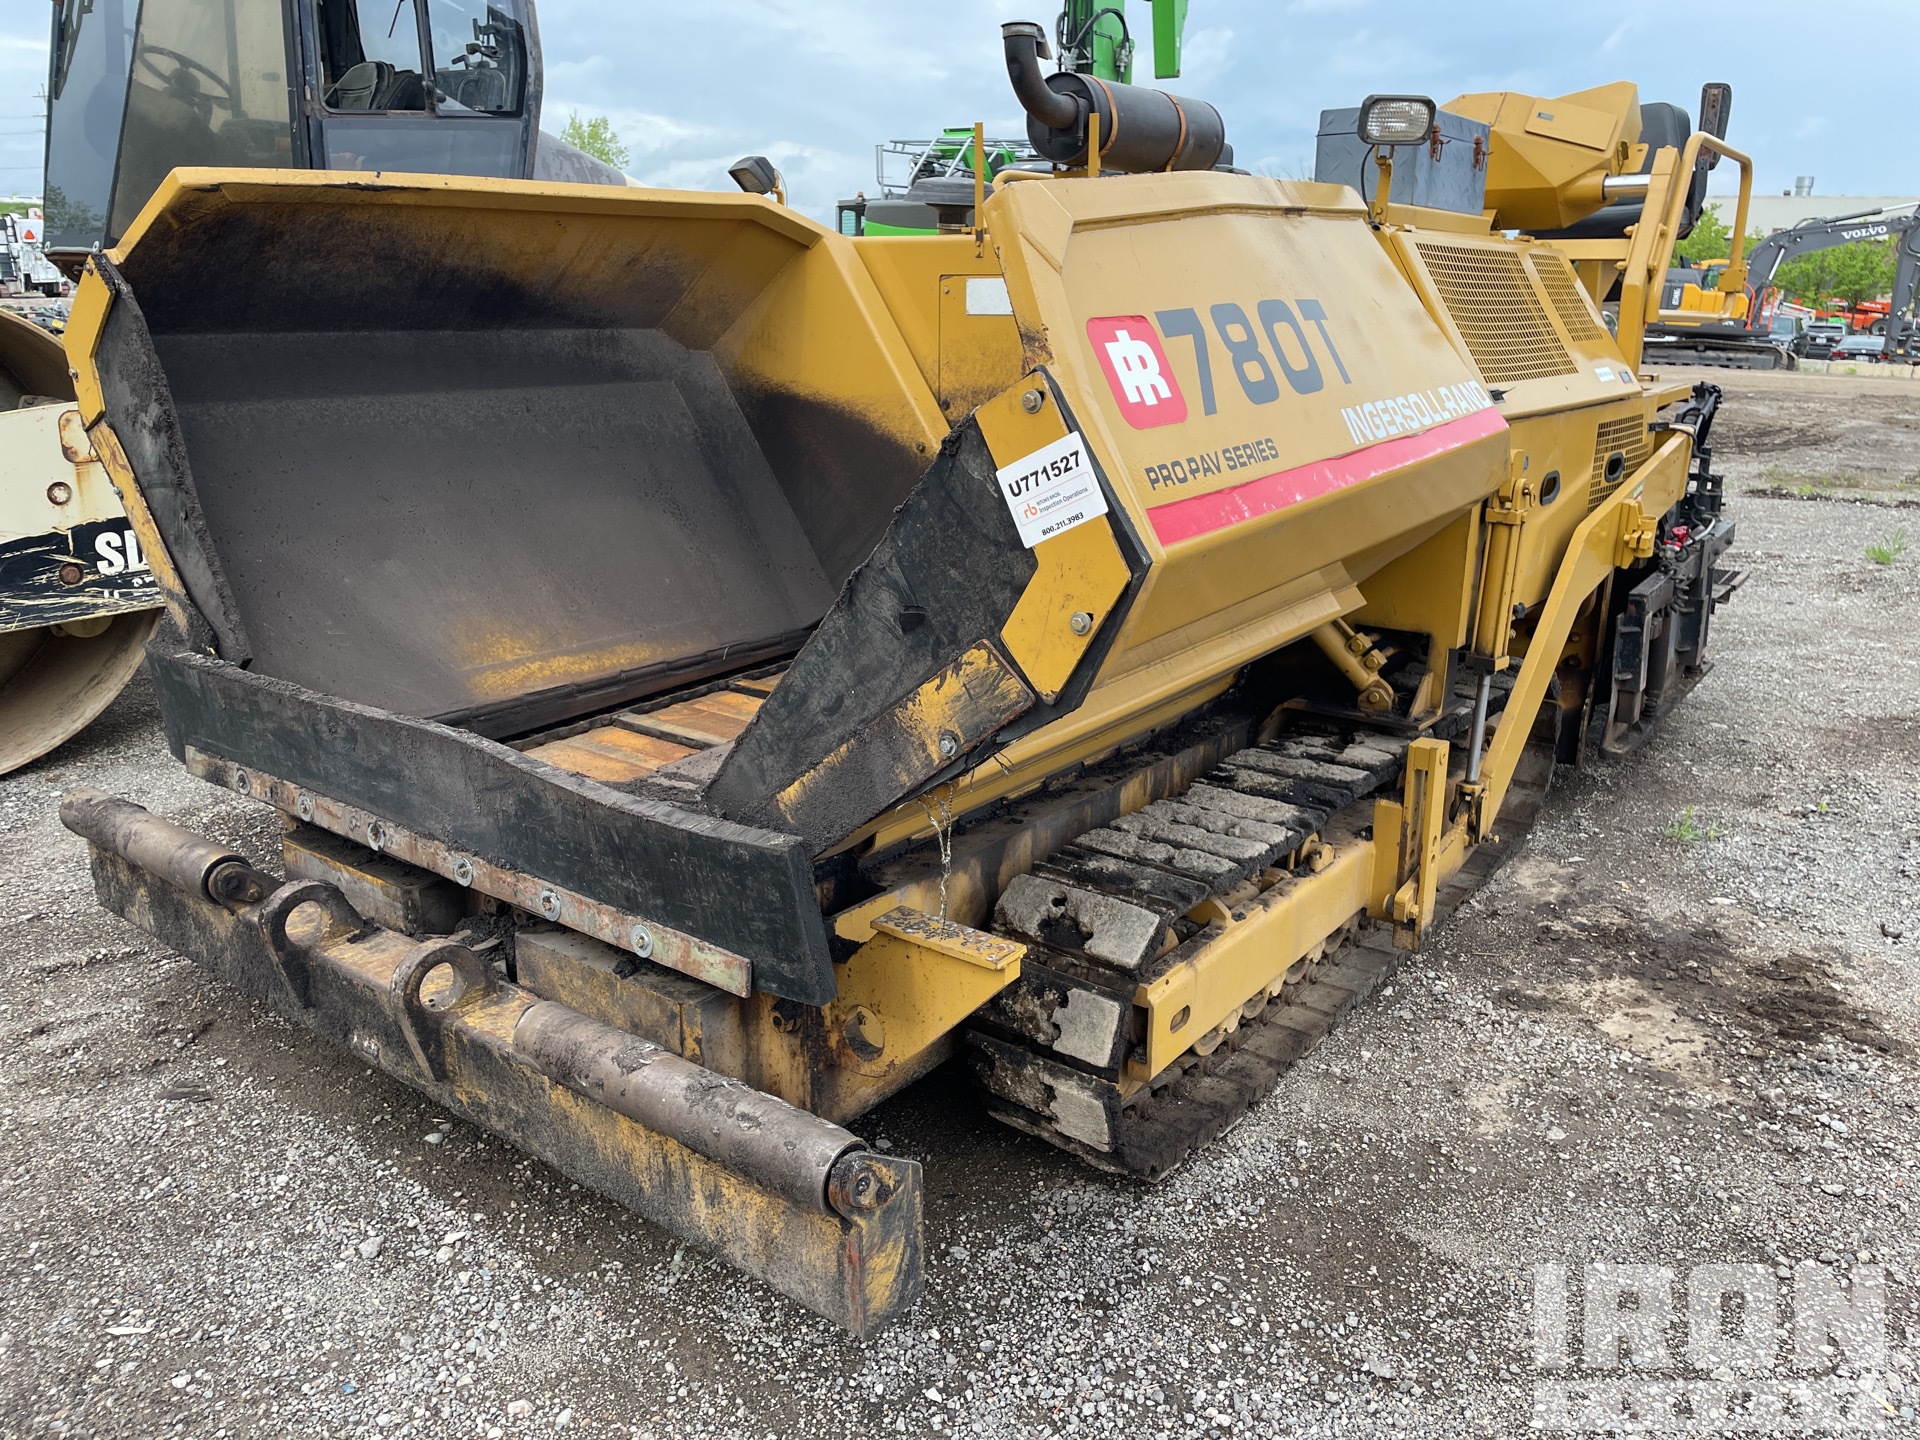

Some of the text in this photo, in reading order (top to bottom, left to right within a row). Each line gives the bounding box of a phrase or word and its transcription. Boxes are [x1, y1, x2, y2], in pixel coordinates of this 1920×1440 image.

[1841, 224, 1888, 240] VOLVO
[1154, 298, 1353, 417] 780T
[1340, 379, 1493, 445] INGERSOLL-RAND
[1222, 437, 1280, 471] SERIES
[1007, 449, 1081, 498] U771527
[1038, 486, 1089, 514] Inspection Operations
[1041, 512, 1084, 536] 800.211.3983
